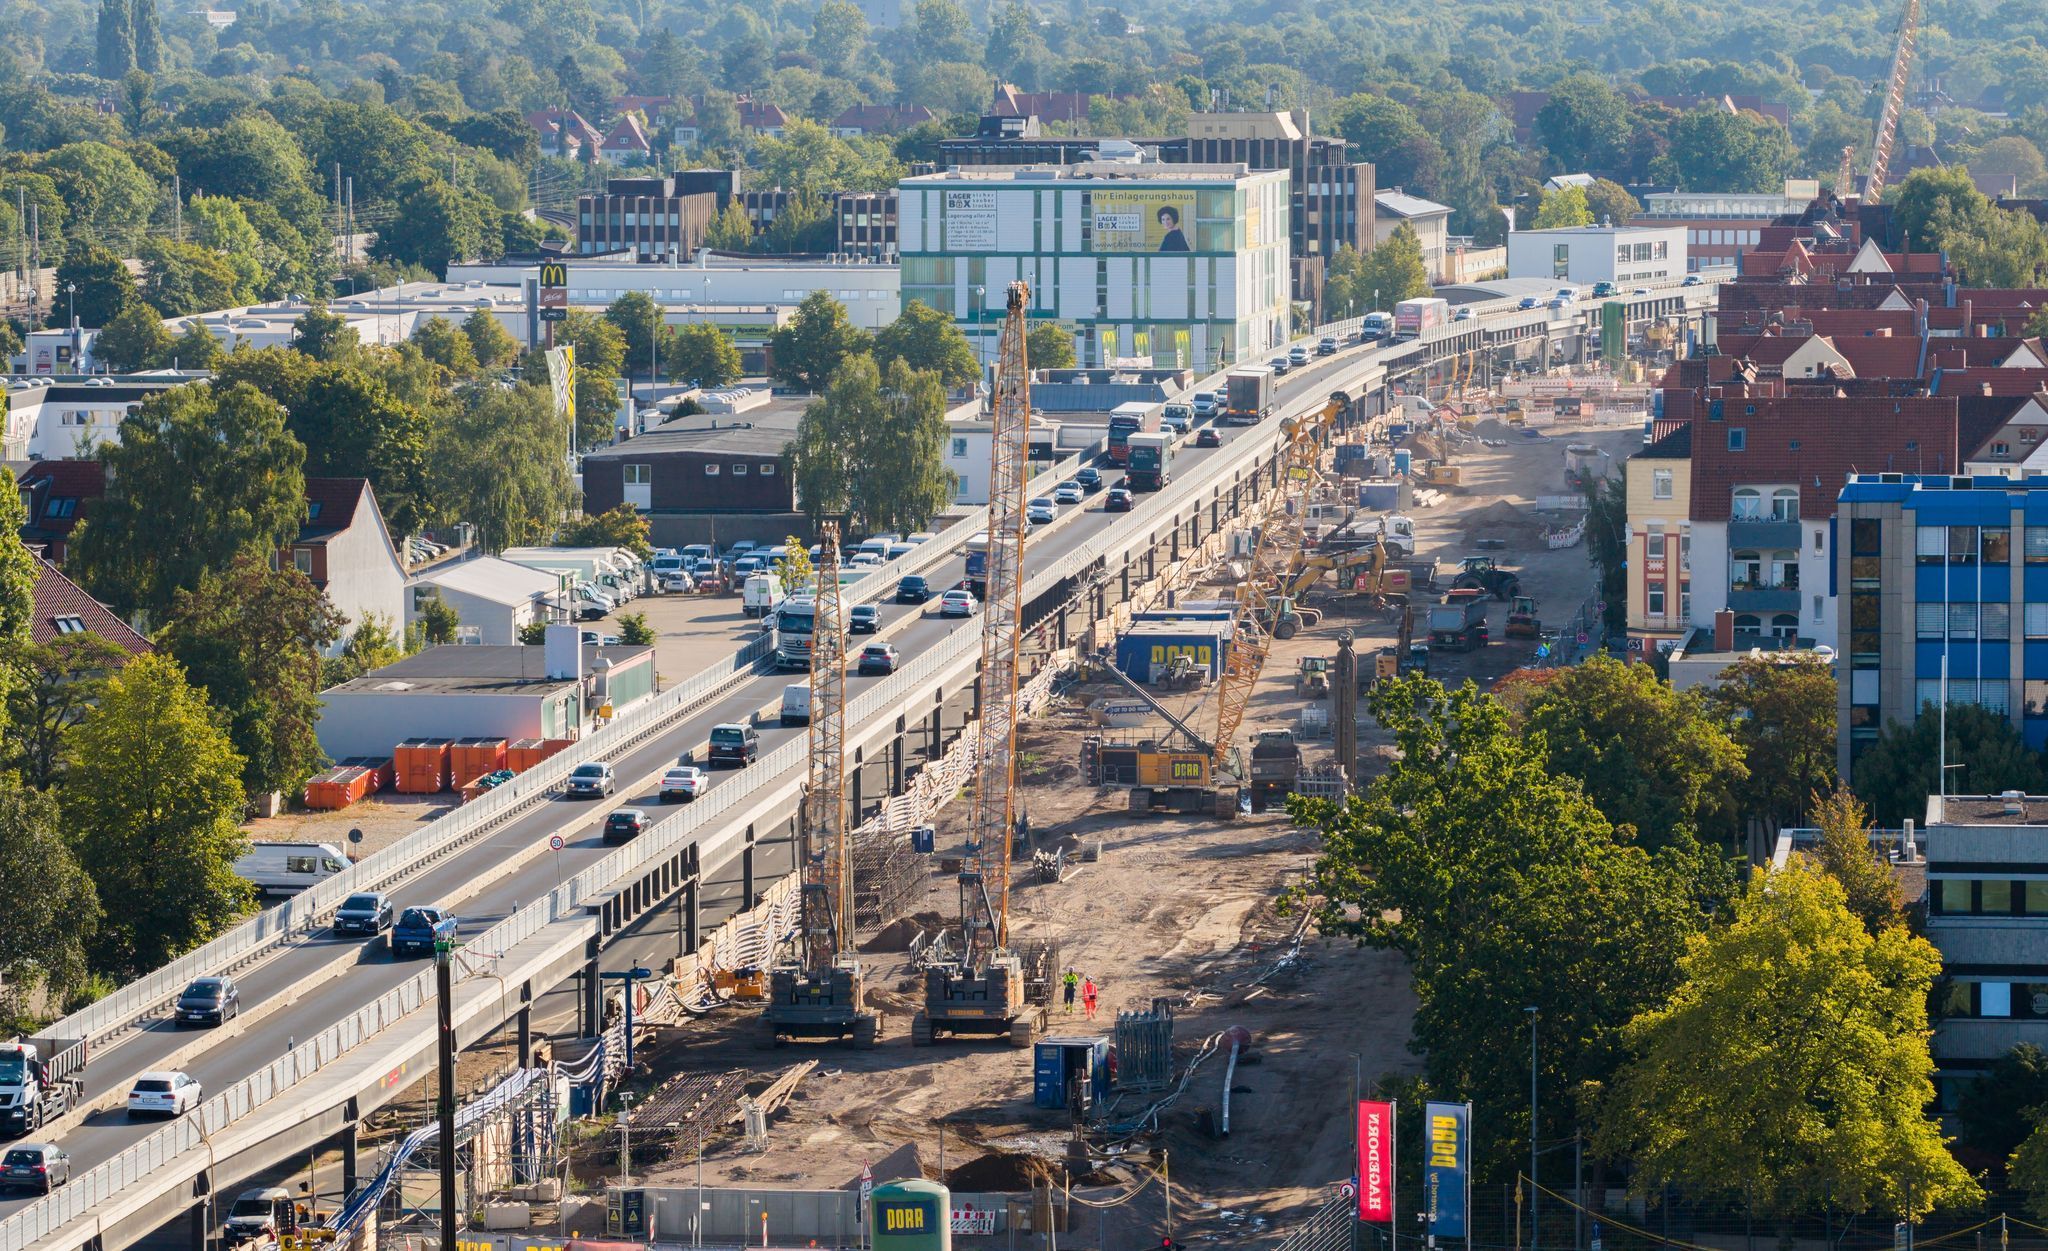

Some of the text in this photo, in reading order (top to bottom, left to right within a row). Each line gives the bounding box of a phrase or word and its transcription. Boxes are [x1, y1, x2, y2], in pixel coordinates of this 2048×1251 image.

[1094, 192, 1194, 201] Ihr Einlagerungshaus
[553, 839, 561, 847] 50
